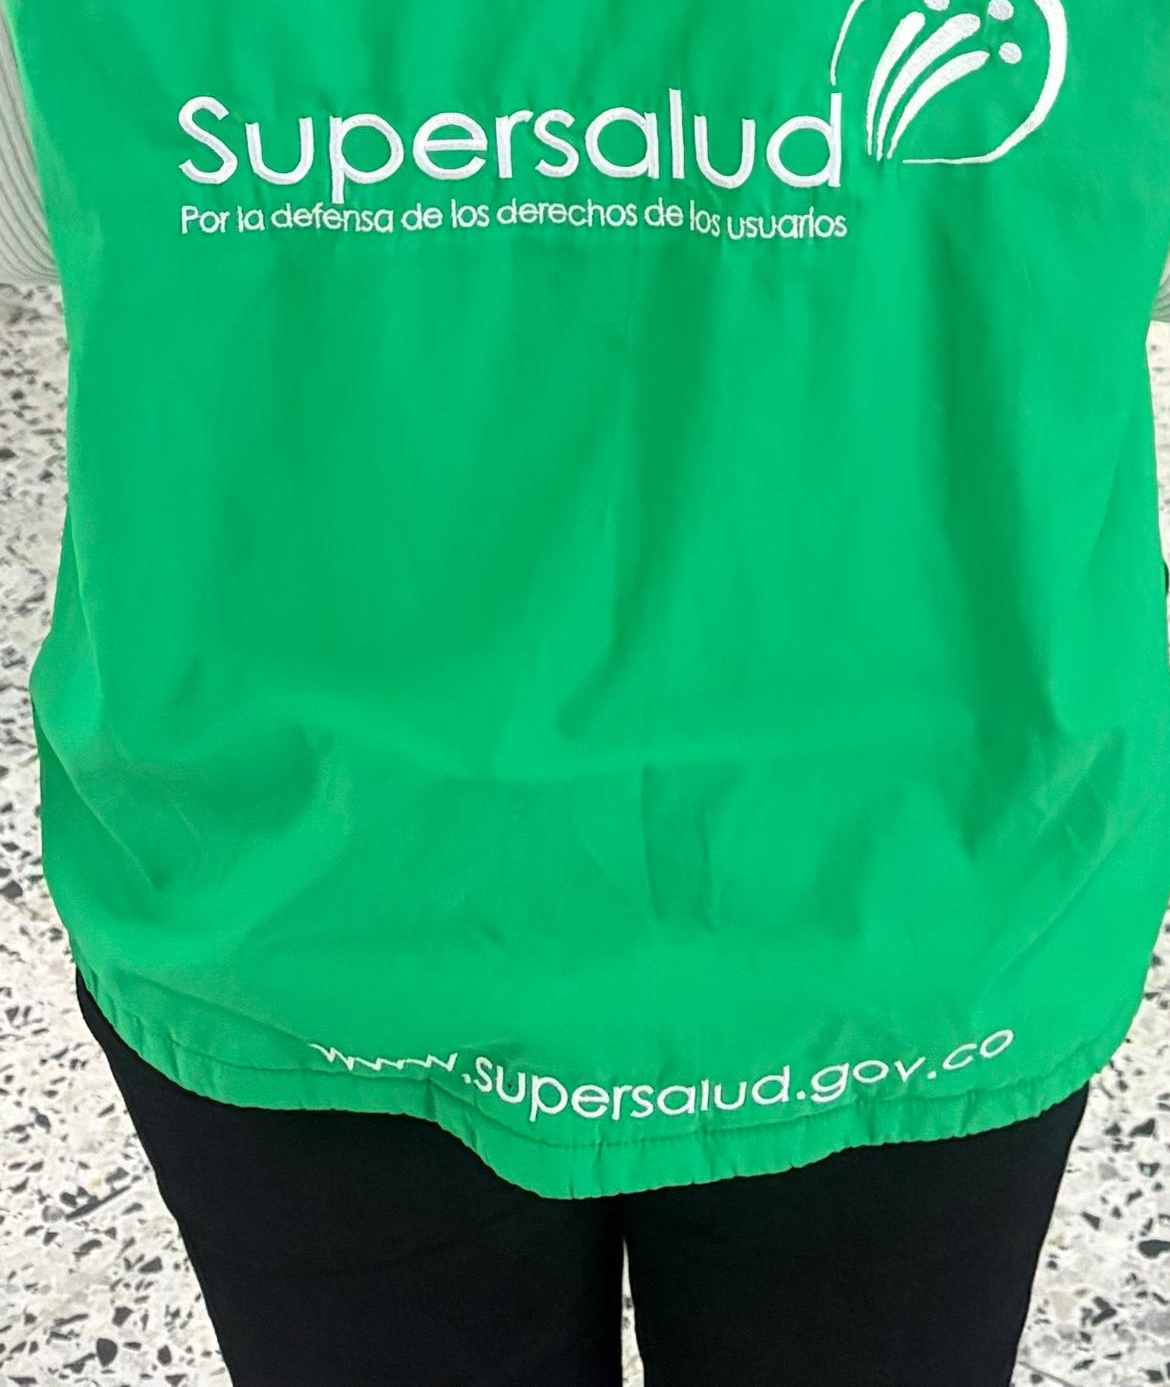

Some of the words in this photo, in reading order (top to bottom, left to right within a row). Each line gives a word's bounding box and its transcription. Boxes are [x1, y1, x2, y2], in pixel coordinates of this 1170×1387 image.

[178, 89, 842, 203] Supersalud
[181, 206, 230, 233] Por
[237, 206, 265, 232] la
[271, 203, 394, 233] defensa
[401, 203, 443, 231] de
[451, 199, 490, 228] los
[496, 198, 638, 227] derechos
[644, 198, 684, 226] de
[690, 200, 720, 237] los
[727, 207, 847, 240] usuarios
[310, 1030, 1014, 1121] www.supersalud.gov.co
